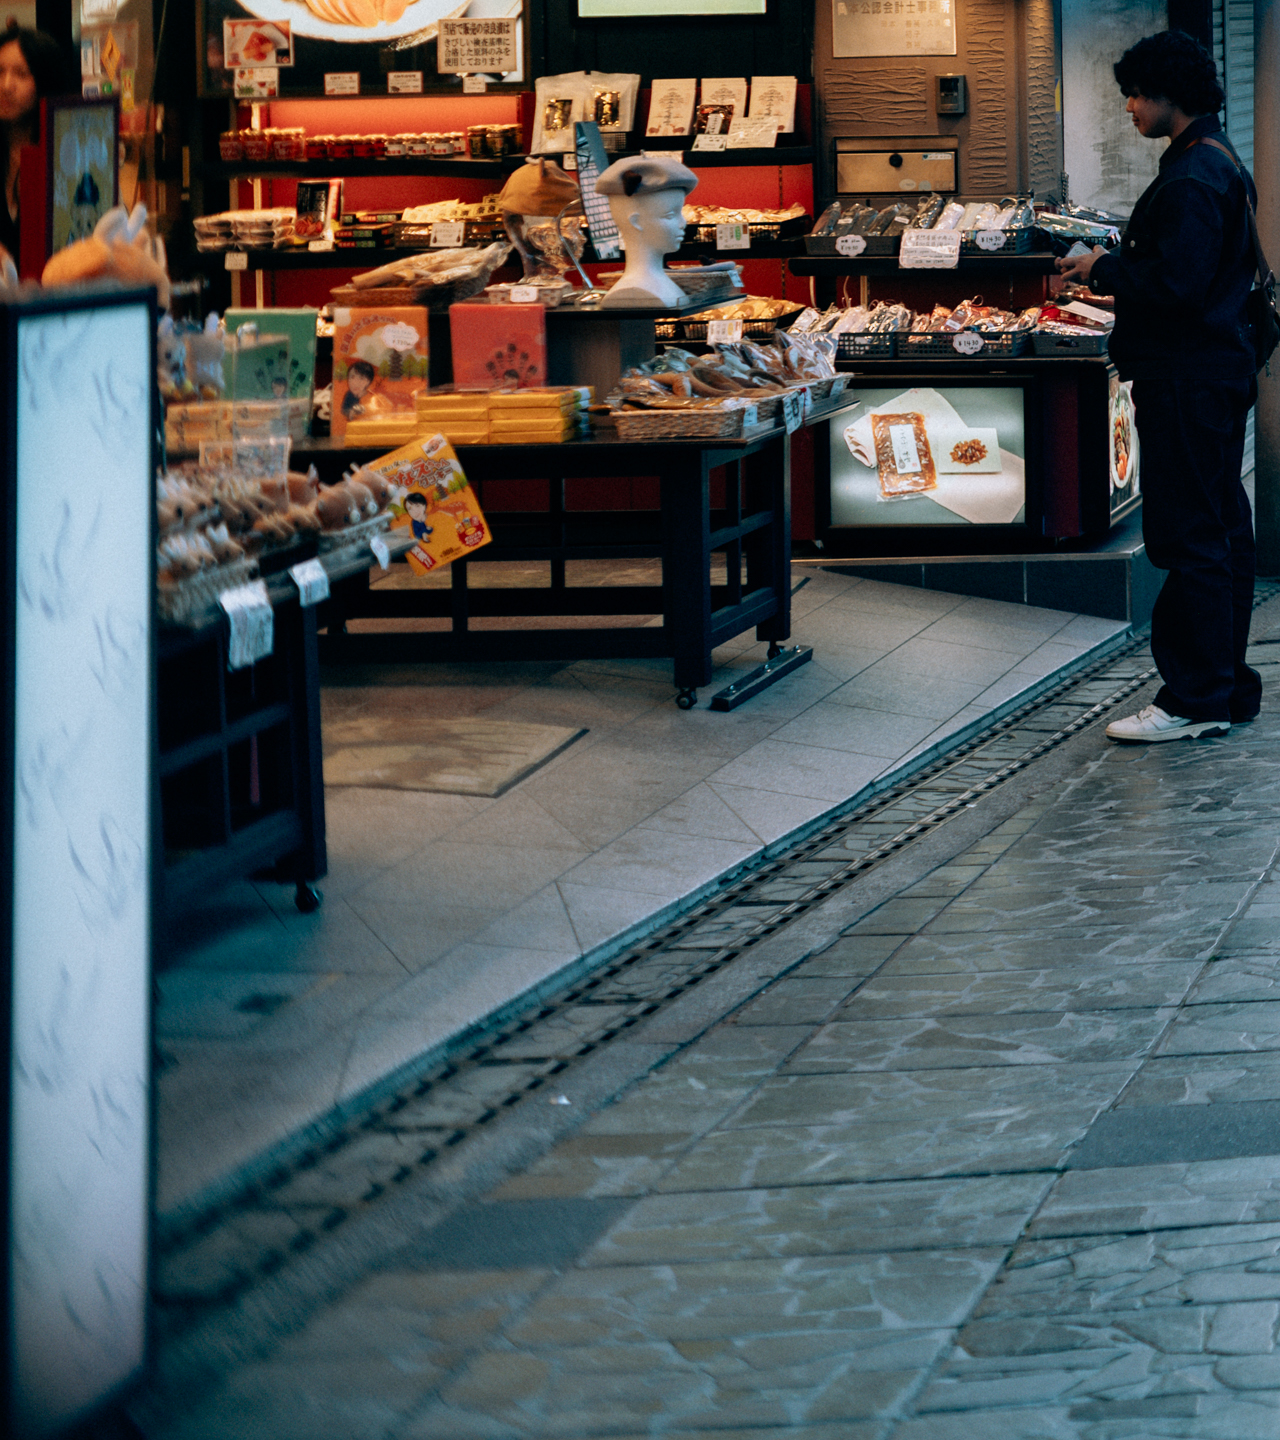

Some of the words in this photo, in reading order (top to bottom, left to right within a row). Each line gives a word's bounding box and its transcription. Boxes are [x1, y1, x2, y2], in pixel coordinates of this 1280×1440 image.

[444, 58, 503, 67] 使用しております
